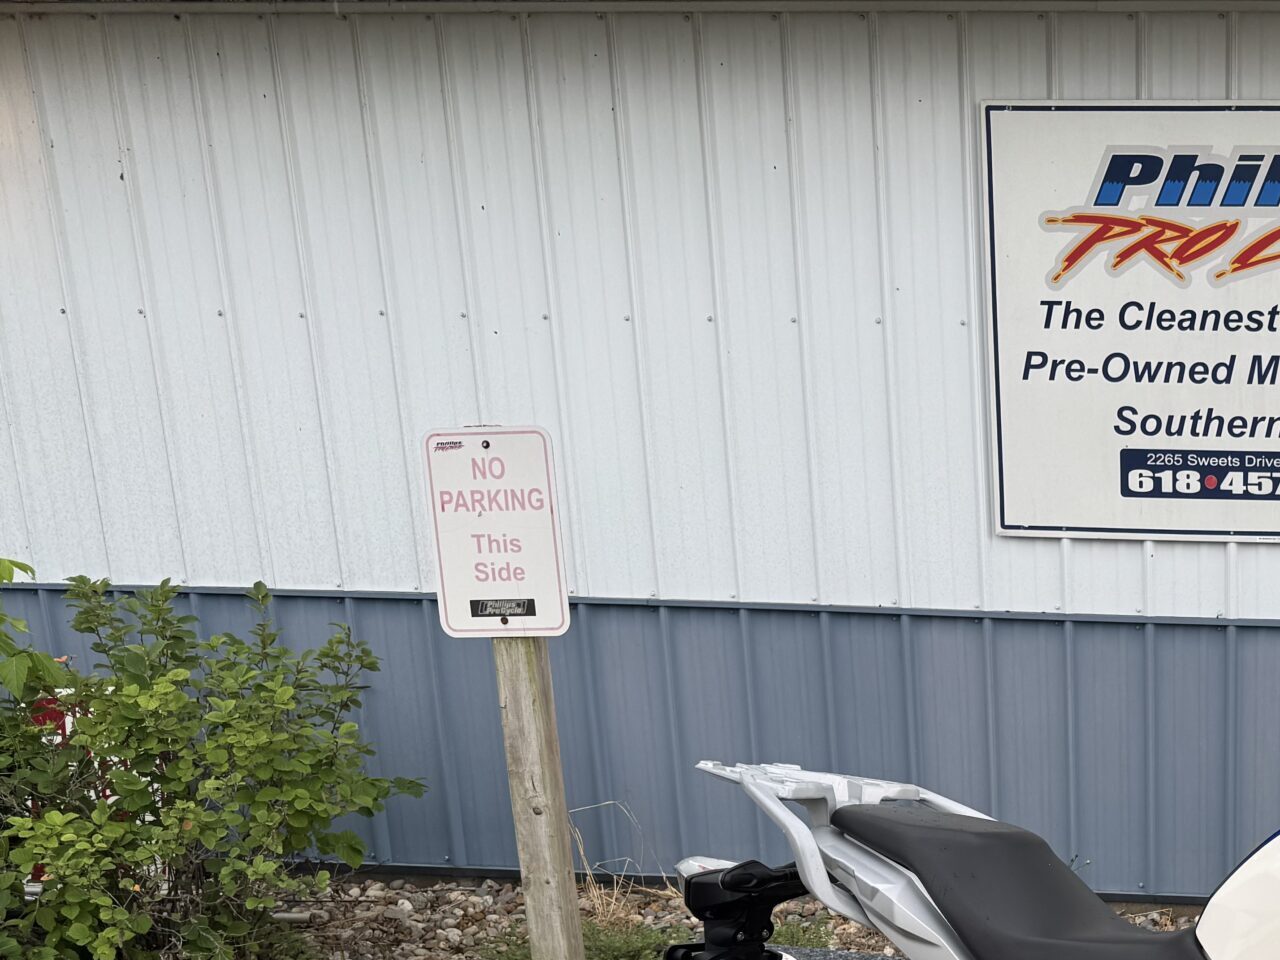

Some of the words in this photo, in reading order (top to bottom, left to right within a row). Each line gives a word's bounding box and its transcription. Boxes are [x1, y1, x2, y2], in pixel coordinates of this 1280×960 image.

[1045, 212, 1240, 283] PRO
[1039, 300, 1104, 330] The
[1117, 301, 1280, 333] Cleanest
[1021, 351, 1236, 385] Pre-Owned
[470, 457, 506, 481] NO
[1146, 453, 1184, 467] 2265
[1187, 455, 1241, 467] Sweets
[439, 488, 546, 513] PARKING
[471, 534, 523, 554] This
[474, 563, 526, 583] Side
